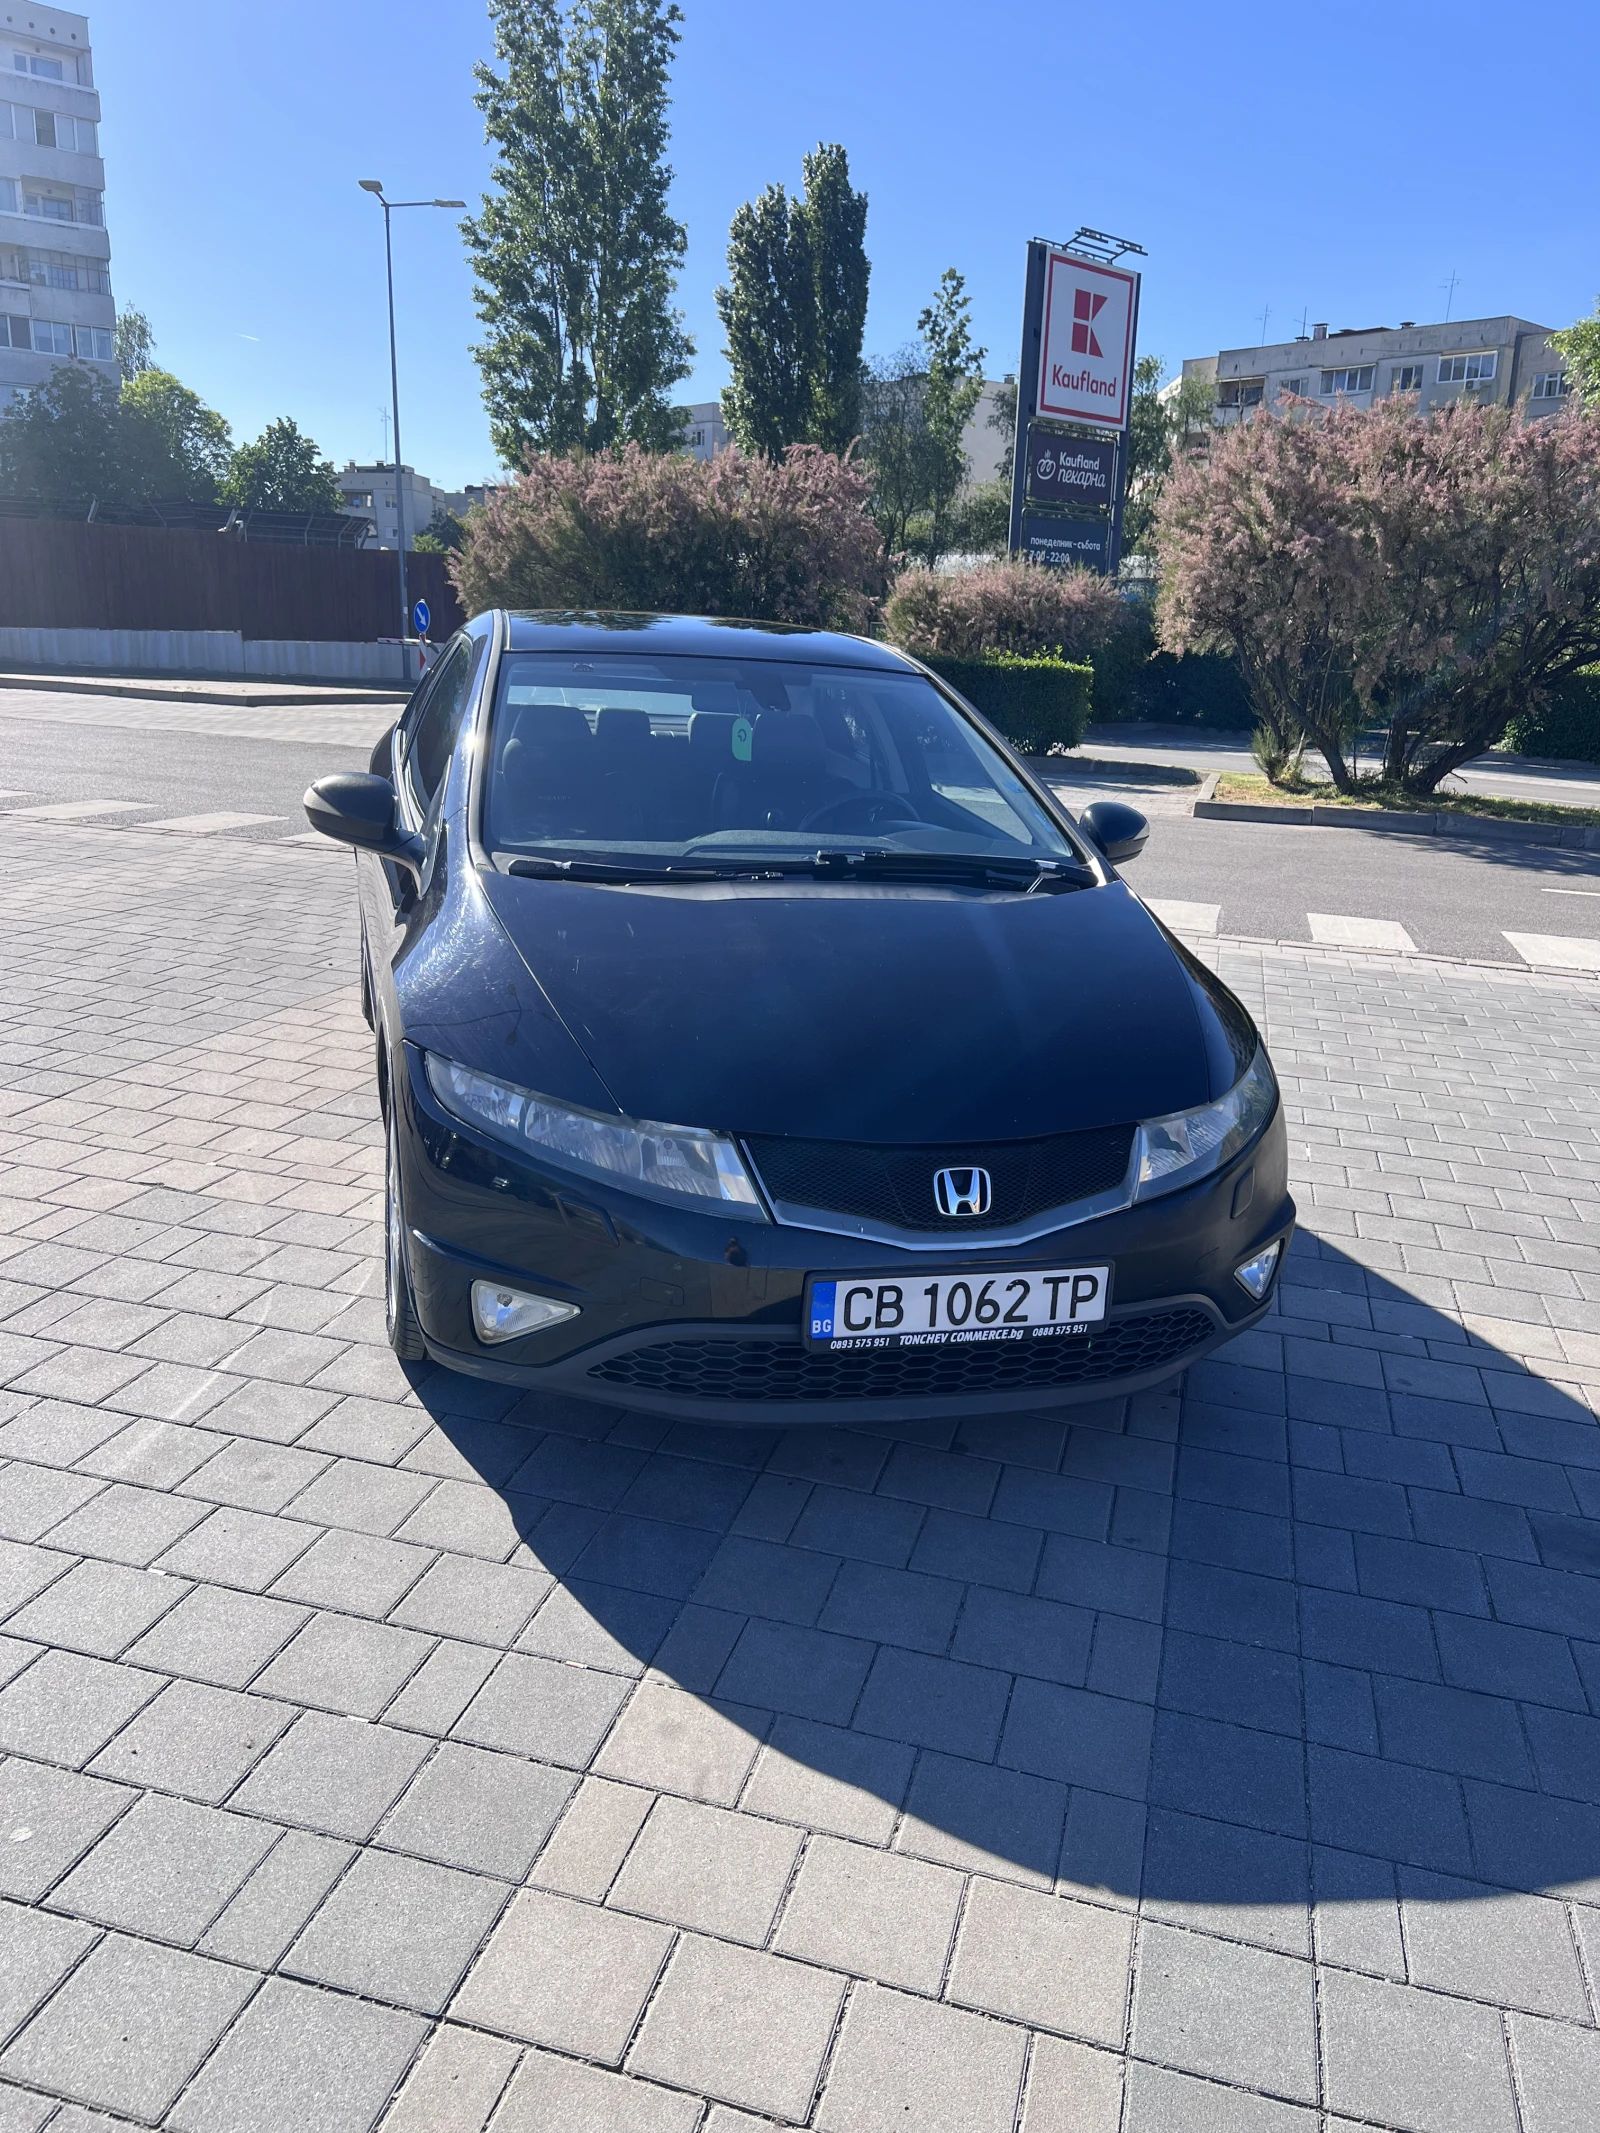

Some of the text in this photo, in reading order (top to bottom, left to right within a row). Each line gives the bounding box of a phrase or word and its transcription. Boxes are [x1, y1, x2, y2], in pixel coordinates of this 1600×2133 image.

[1052, 364, 1117, 398] Kaufland
[1059, 451, 1100, 471] Kaufland
[1057, 468, 1107, 490] пекарна
[843, 1274, 1099, 1332] CB 1062 TP
[812, 1319, 832, 1334] BG
[830, 1323, 1088, 1350] 0893 575 951 TONCHEV COMMERCE.bg 0888 575 951
